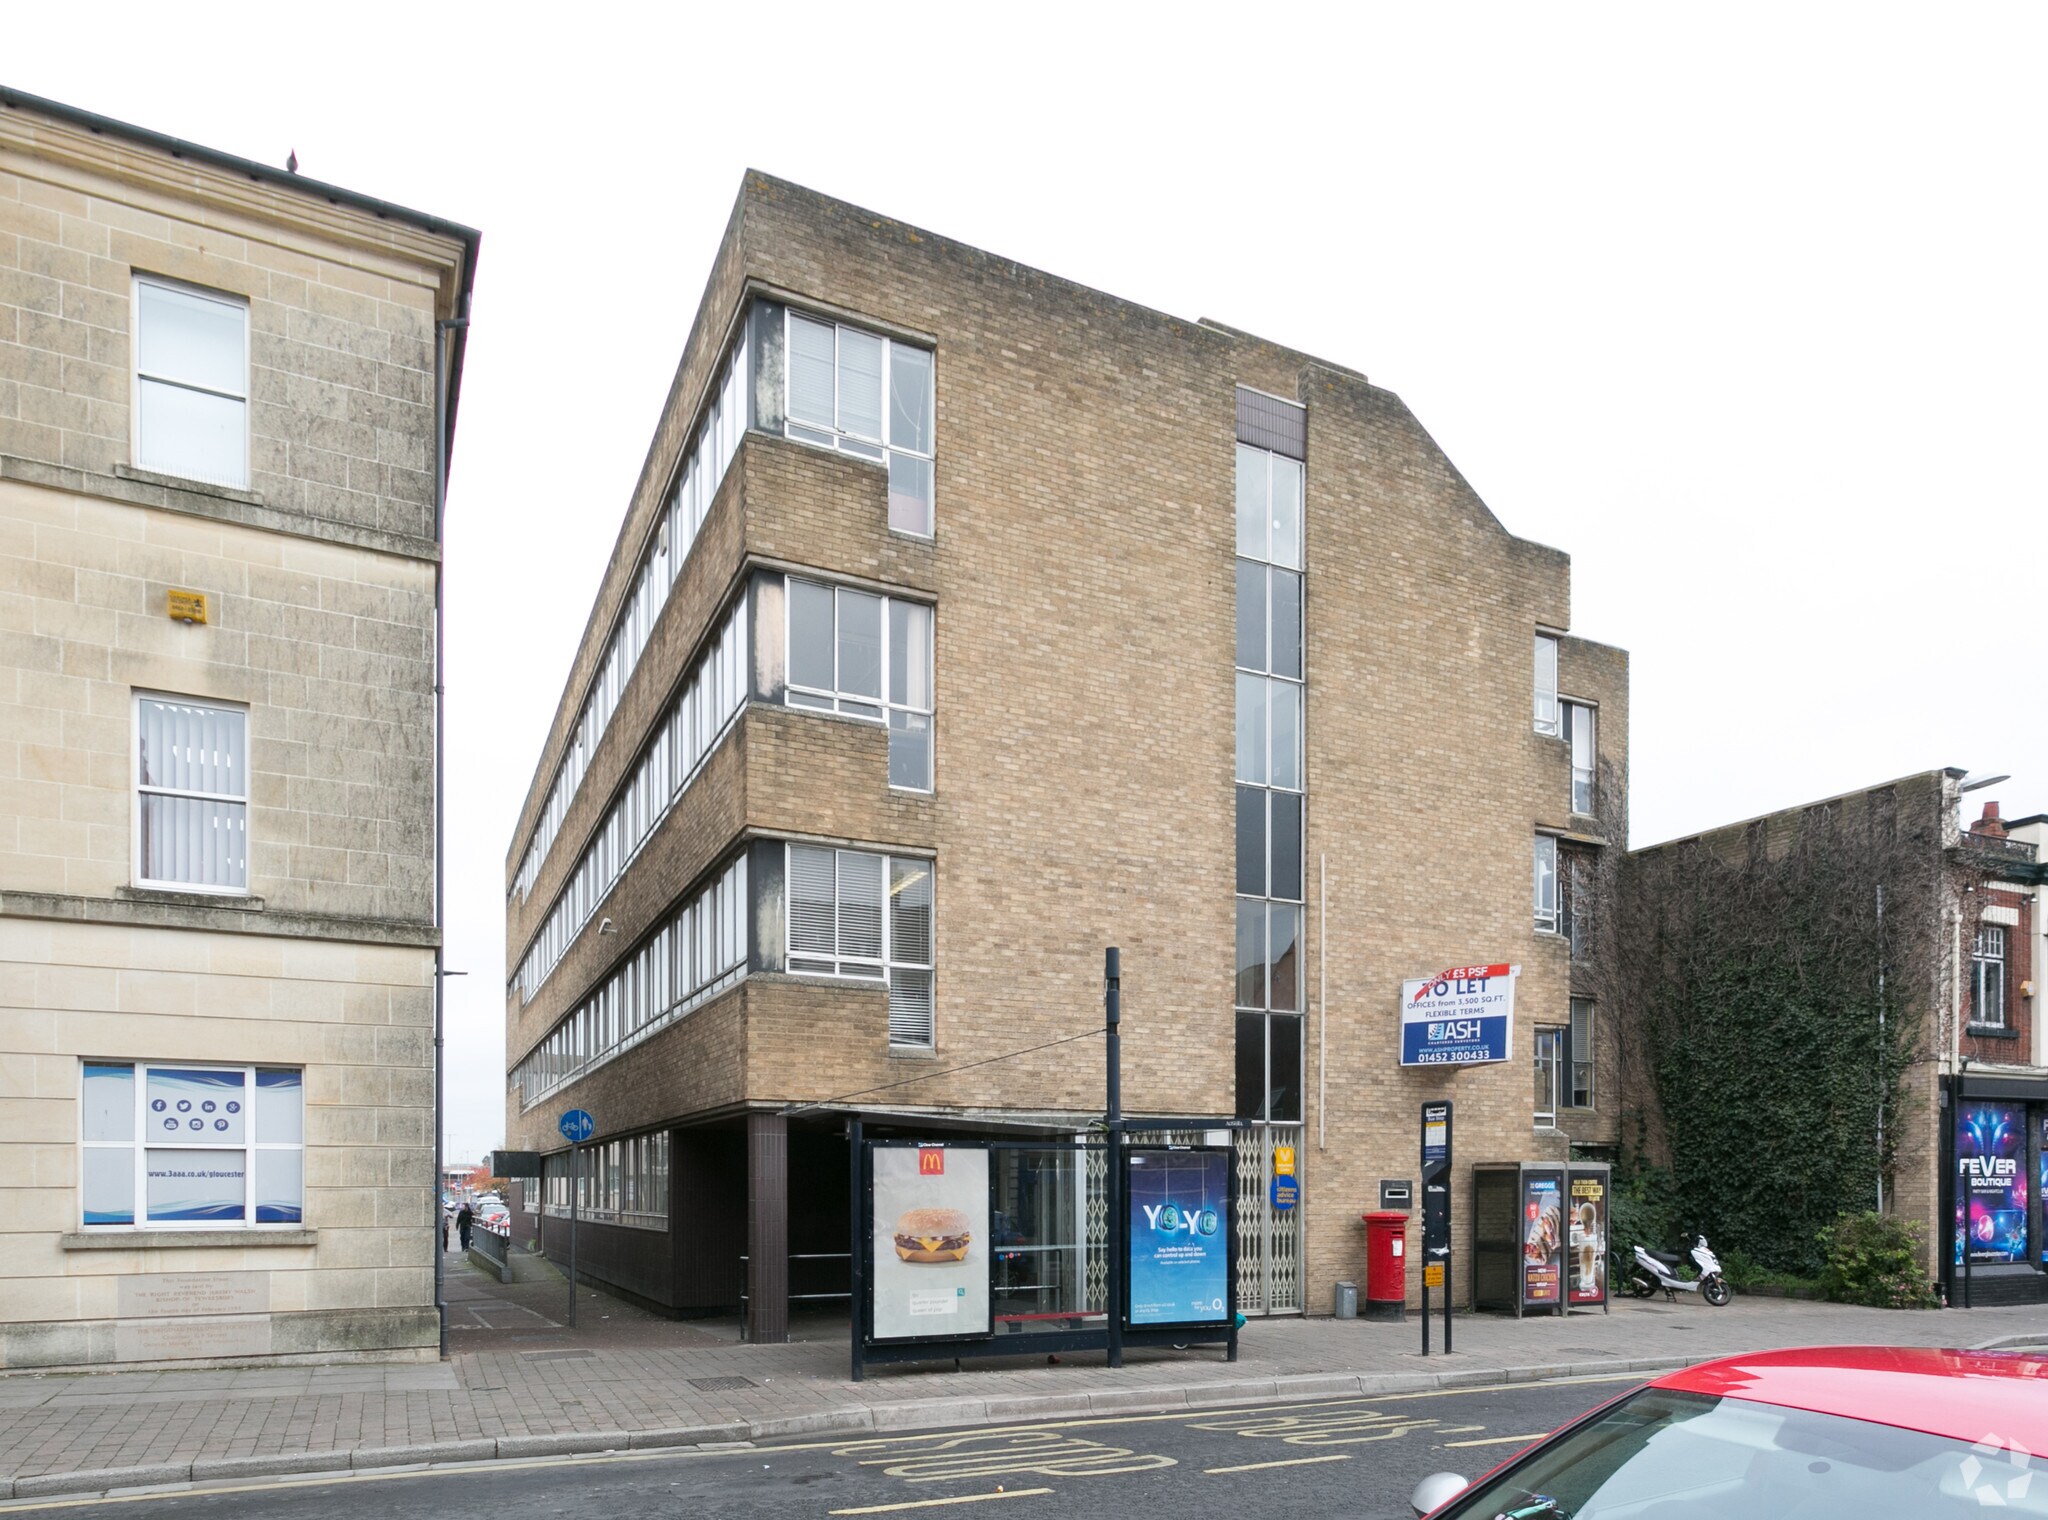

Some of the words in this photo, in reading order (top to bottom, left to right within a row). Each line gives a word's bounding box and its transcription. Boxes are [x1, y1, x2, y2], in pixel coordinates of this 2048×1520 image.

[1428, 971, 1451, 989] ONLY
[1453, 969, 1466, 979] £5
[1468, 966, 1489, 978] PSF
[1456, 976, 1490, 995] LET
[1407, 1000, 1436, 1010] OFFICES
[1425, 1009, 1457, 1018] FLEXIBLE
[1460, 1007, 1485, 1016] TERMS
[1444, 1020, 1481, 1040] ASH
[1418, 1044, 1490, 1054] WWW.ASHPROPERTY.CO.UK
[1418, 1052, 1448, 1063] 01452
[1450, 1050, 1490, 1061] 300433
[148, 1170, 245, 1178] www.3aaa.co.uk/gloucester
[1535, 1182, 1556, 1190] GREGGS
[1971, 1178, 2012, 1187] BOUTIQUE
[1582, 1186, 1591, 1194] BEST
